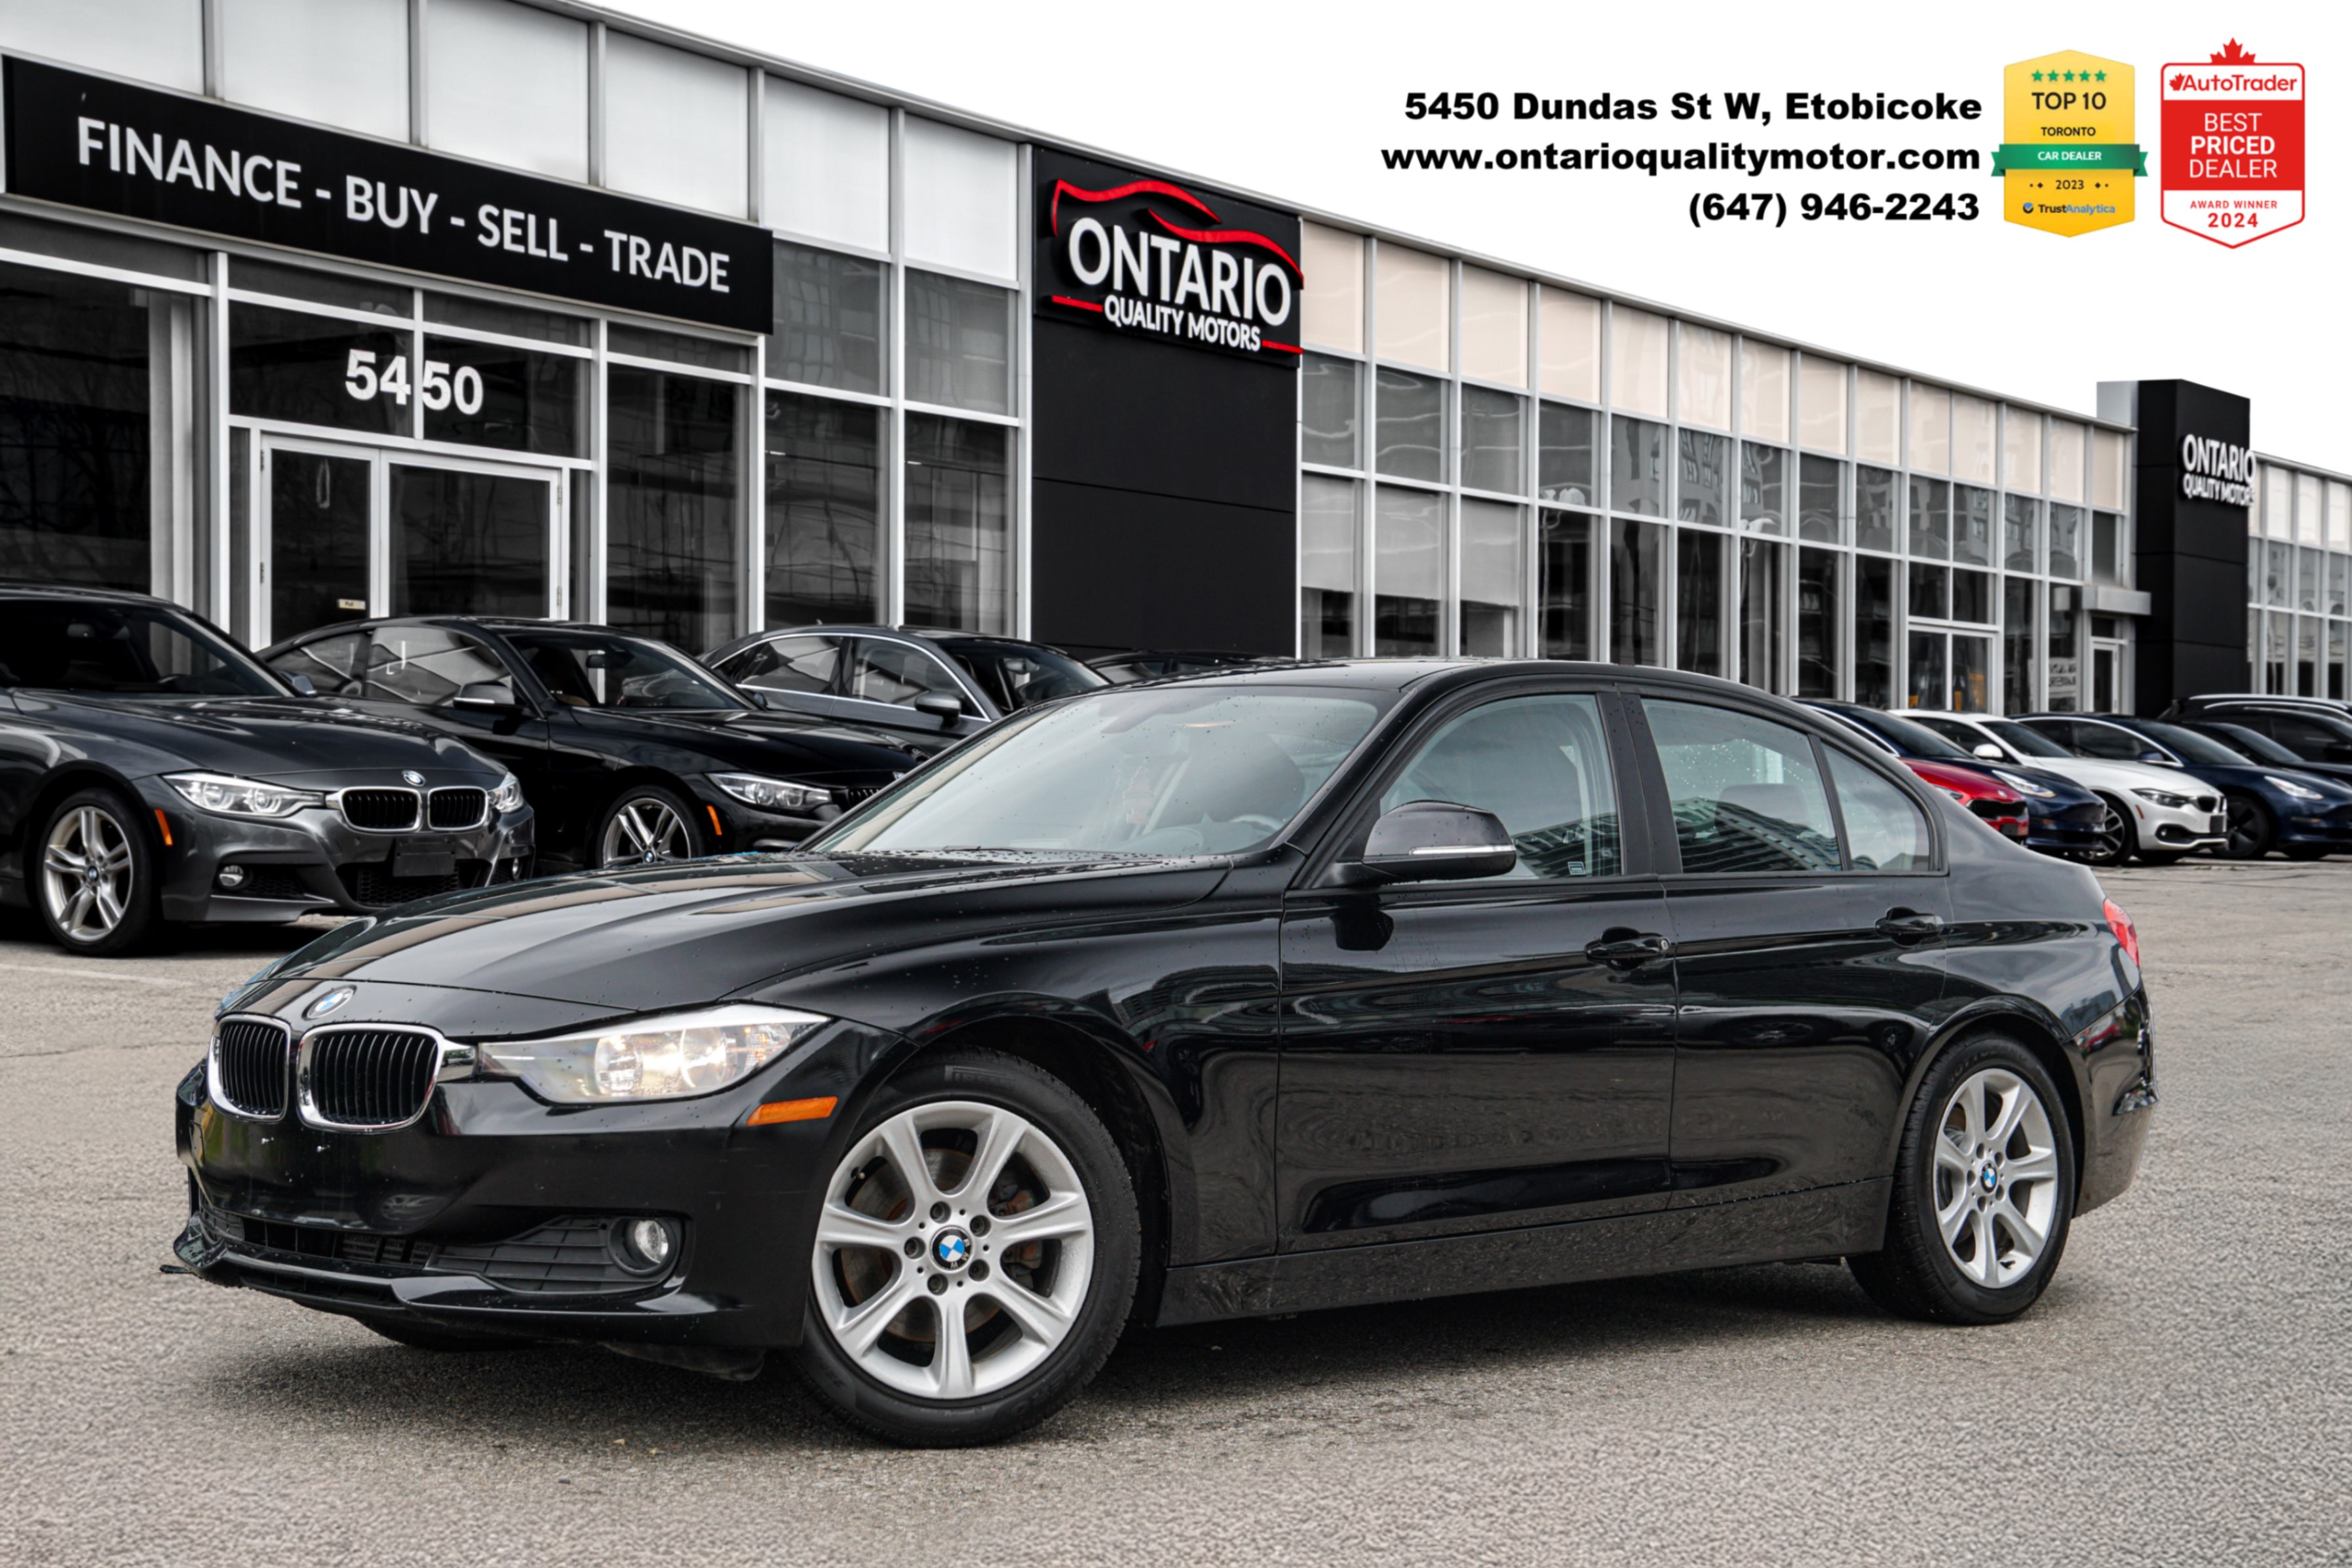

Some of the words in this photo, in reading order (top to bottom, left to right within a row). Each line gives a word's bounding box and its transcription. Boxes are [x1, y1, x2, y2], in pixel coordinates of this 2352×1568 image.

[78, 116, 301, 208] FINANCE
[346, 175, 438, 234] BUY
[478, 204, 568, 261] SELL
[604, 229, 729, 293] TRADE
[1069, 217, 1291, 326] ONTARIO
[1104, 294, 1184, 335] QUALITY
[1188, 312, 1261, 351] MOTORS
[345, 349, 483, 415] 5450
[2183, 433, 2256, 485] ONTARIO
[2183, 472, 2220, 500] QUALITY
